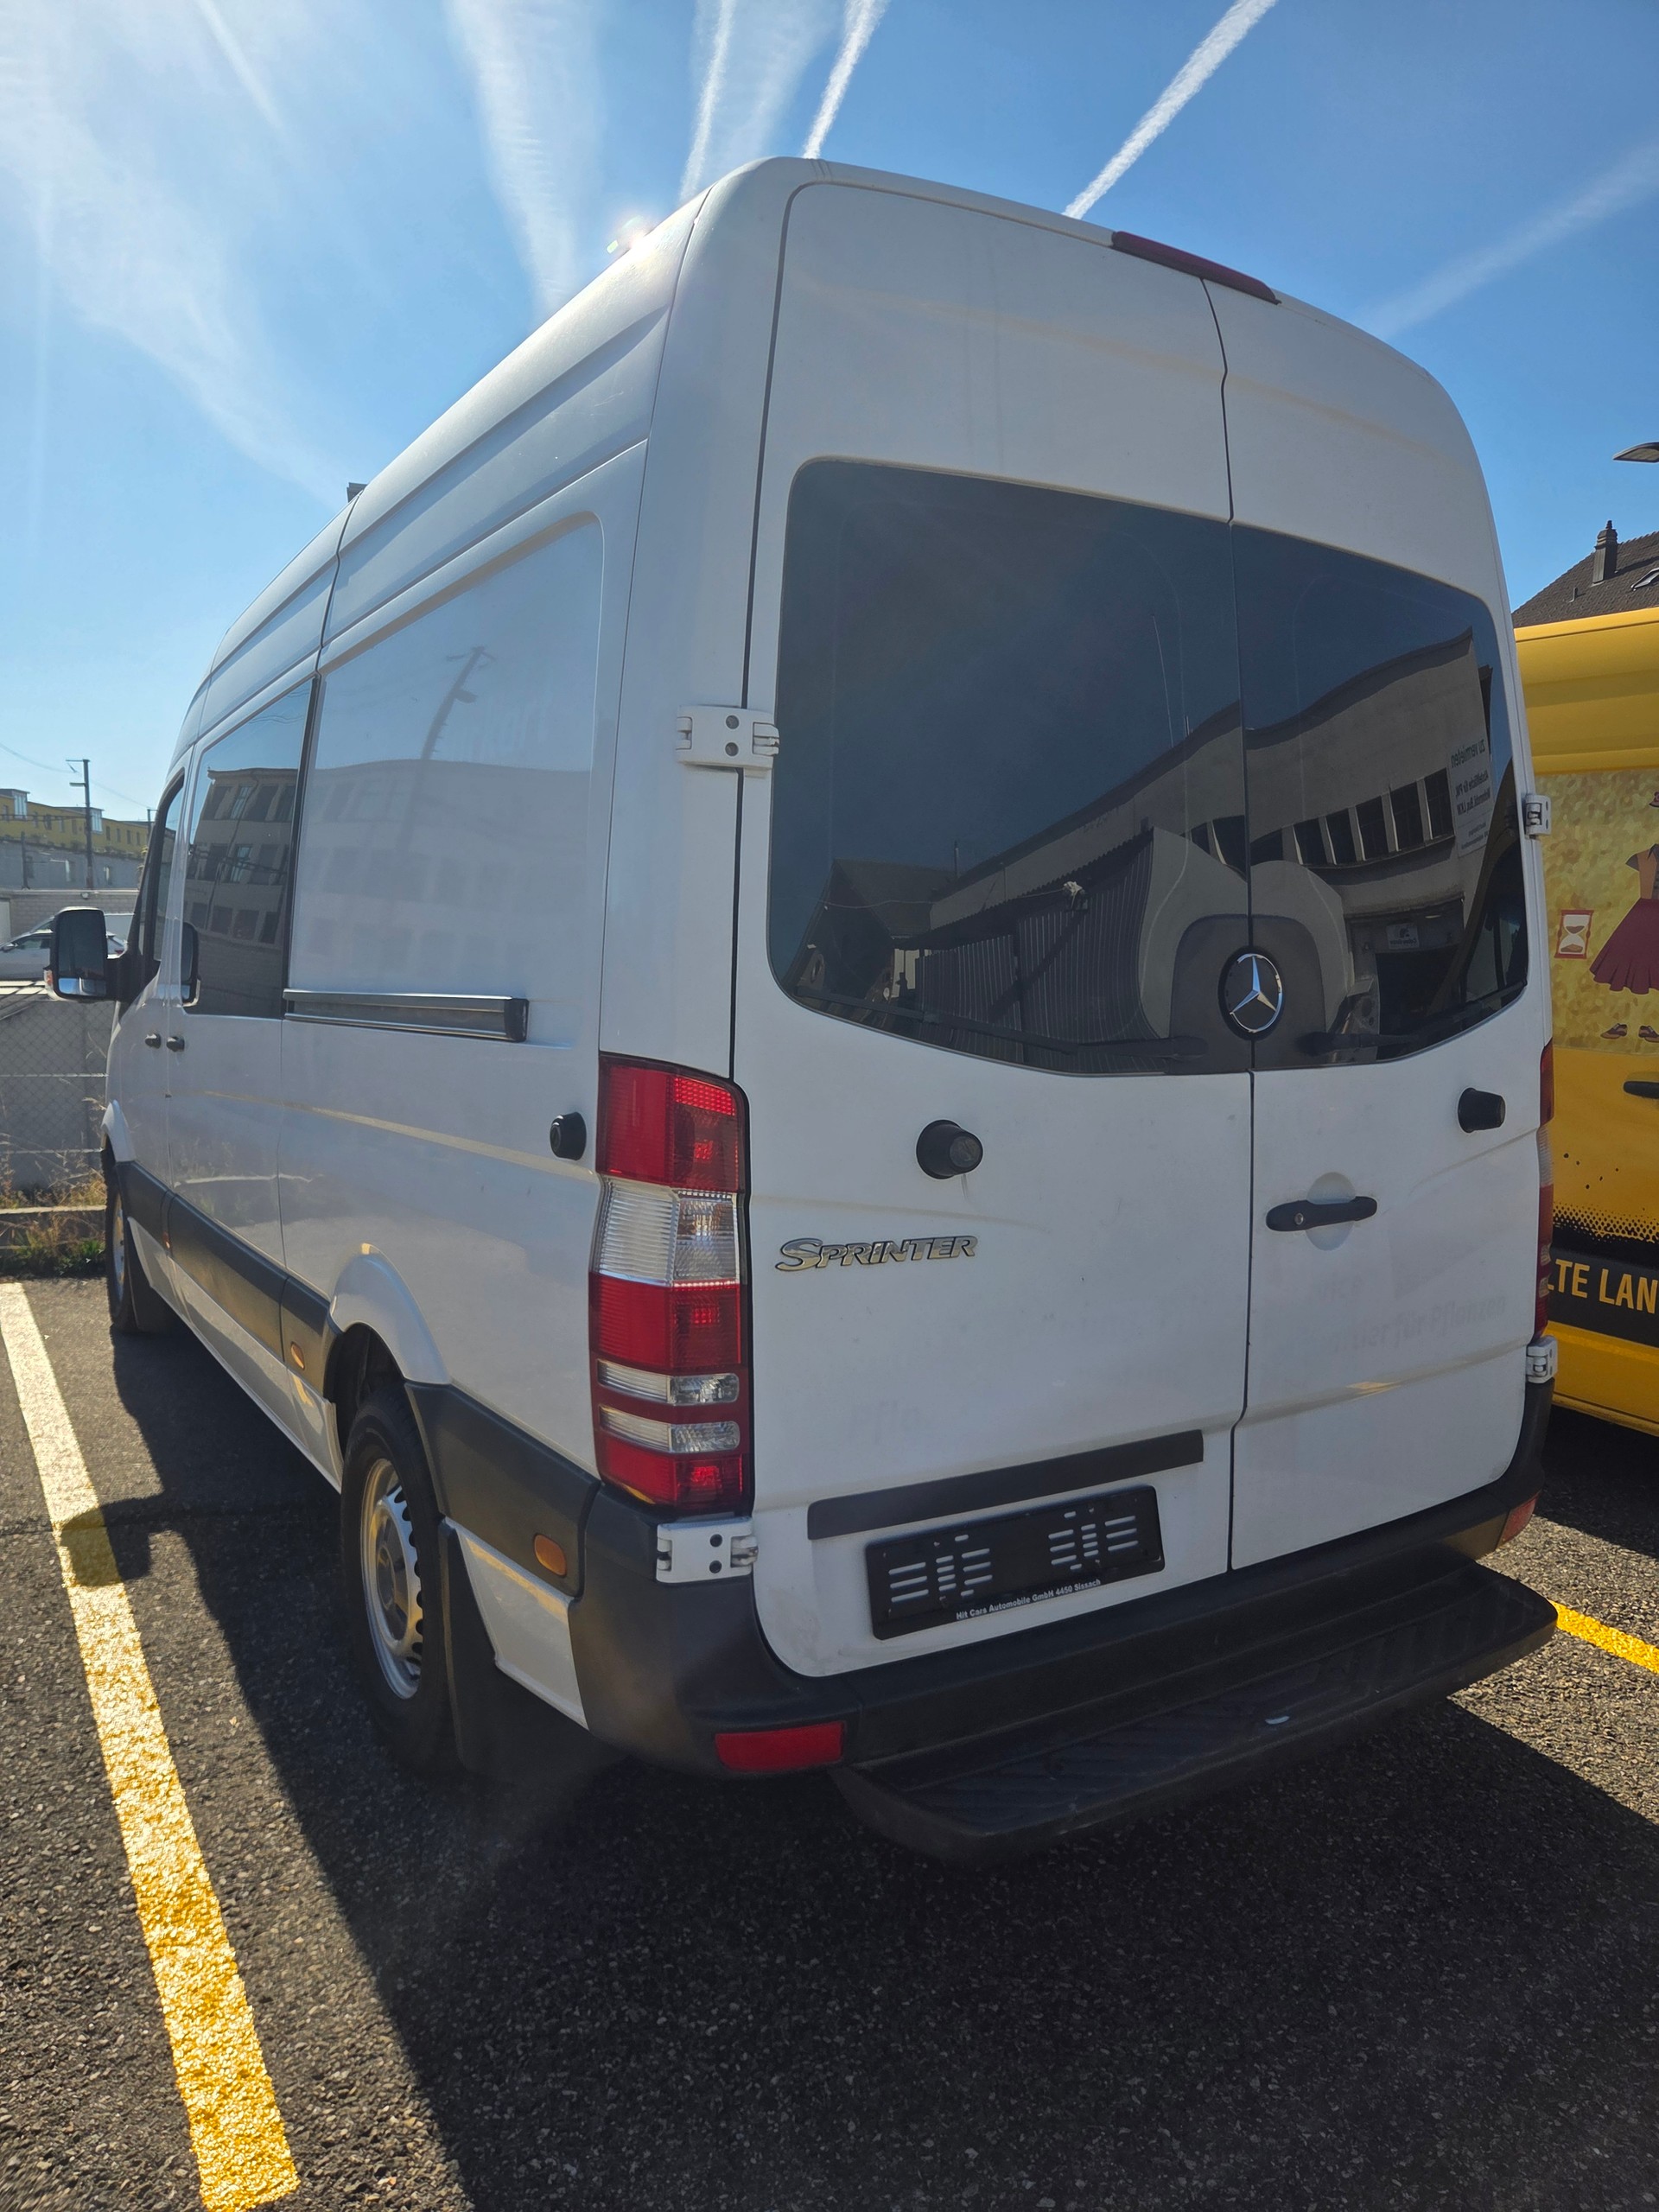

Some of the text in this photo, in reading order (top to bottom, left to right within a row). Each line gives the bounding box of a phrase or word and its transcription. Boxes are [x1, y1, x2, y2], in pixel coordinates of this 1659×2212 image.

[1548, 1258, 1590, 1299] TE
[956, 1578, 1102, 1620] Hit Cars Automobile GmbH 4450 Sissach
